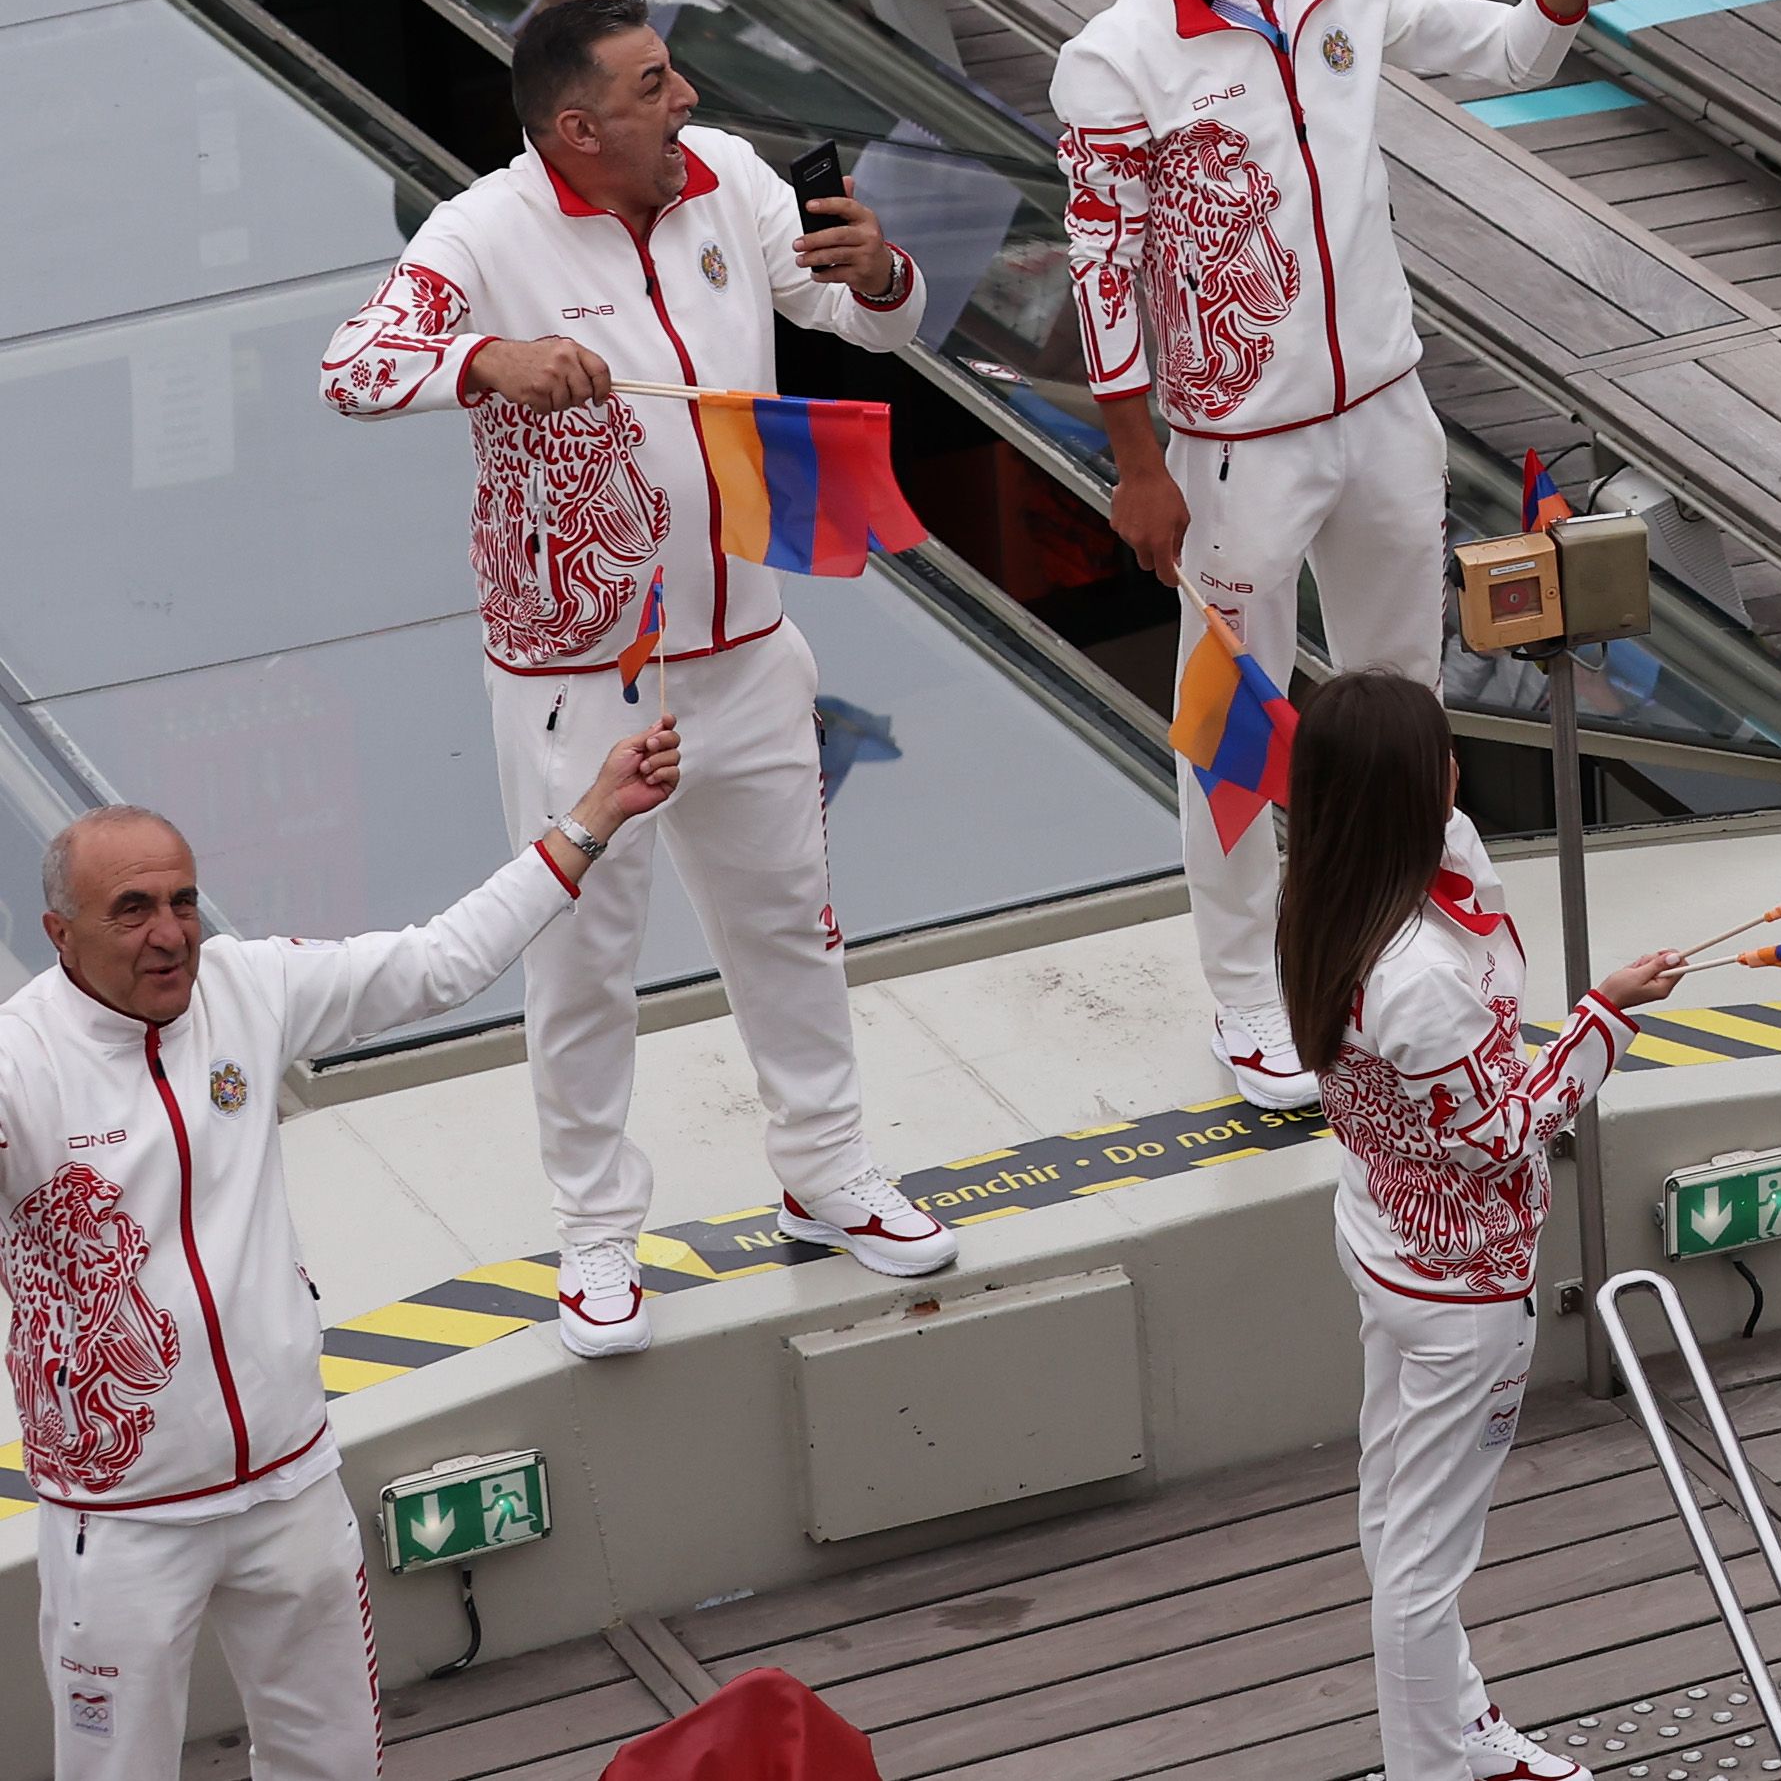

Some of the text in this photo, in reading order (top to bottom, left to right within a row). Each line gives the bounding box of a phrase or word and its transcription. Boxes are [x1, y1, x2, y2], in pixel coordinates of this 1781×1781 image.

[914, 1161, 1061, 1212] ranchir
[1102, 1140, 1167, 1165] Do
[1176, 1118, 1252, 1149] not
